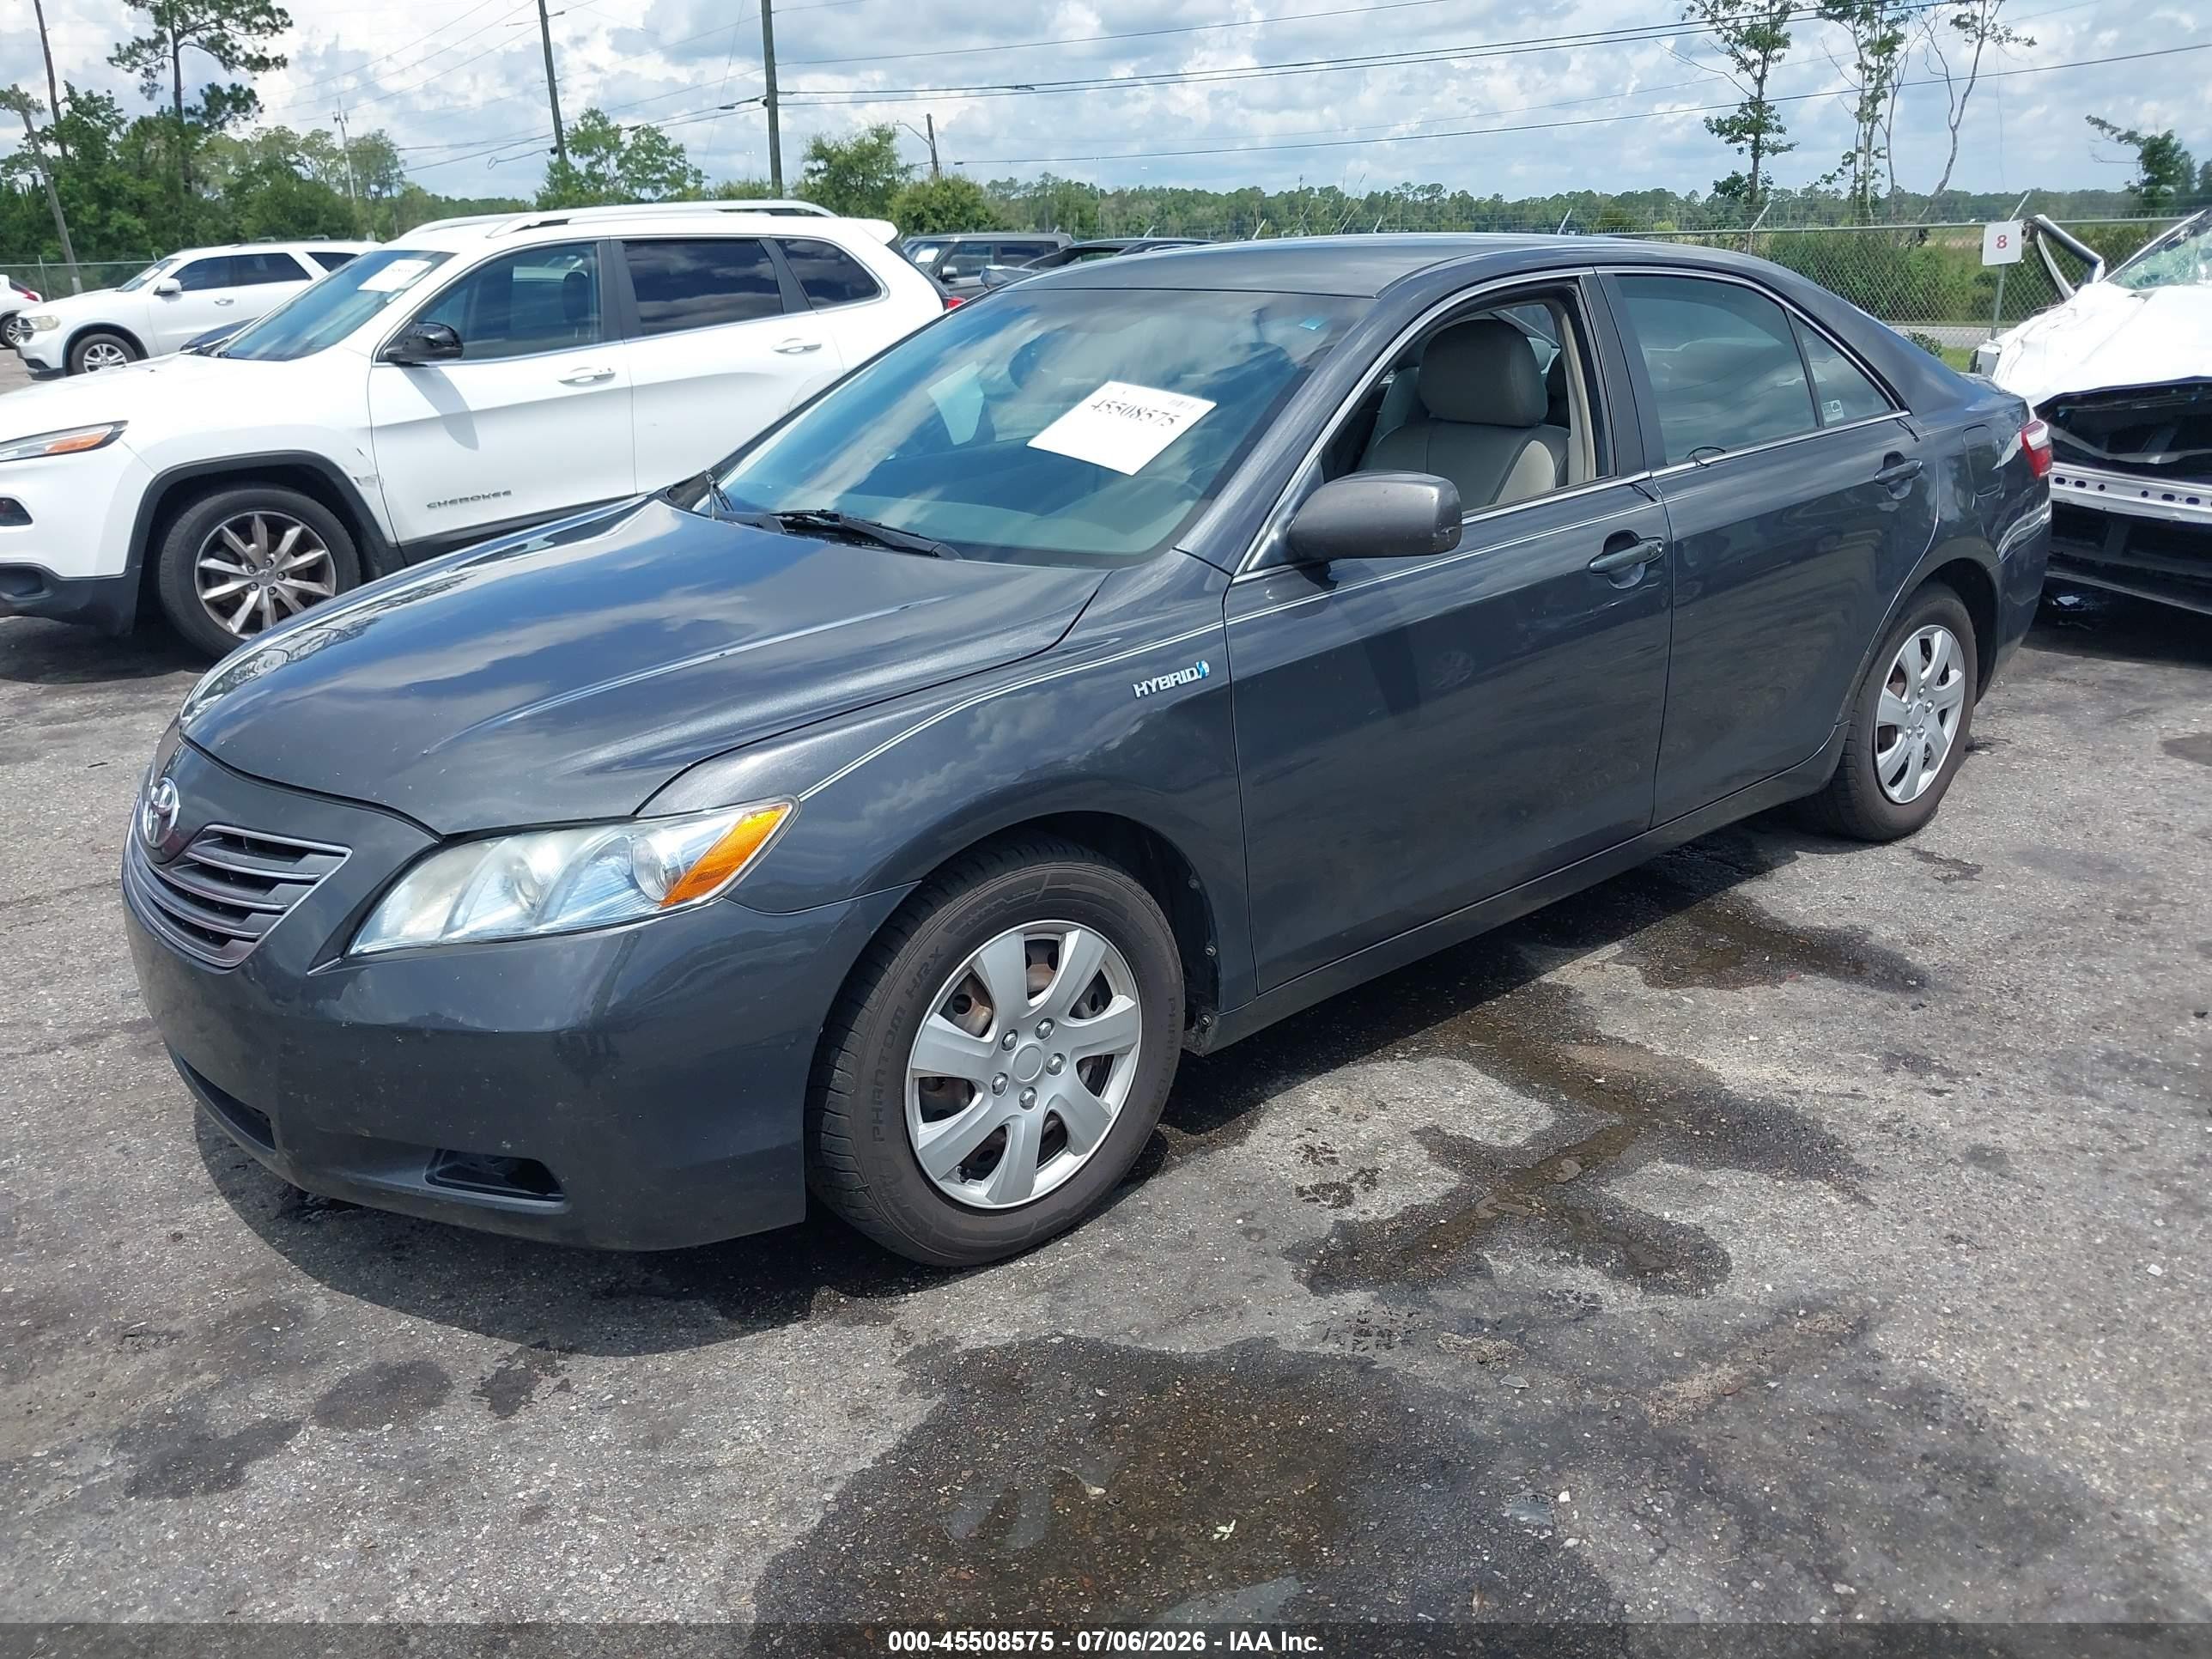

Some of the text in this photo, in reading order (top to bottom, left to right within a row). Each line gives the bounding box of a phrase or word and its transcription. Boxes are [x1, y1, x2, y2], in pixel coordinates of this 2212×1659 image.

[1996, 234, 2007, 249] 8
[1090, 398, 1182, 427] 45508575
[426, 489, 513, 508] CHEROKEE
[1132, 666, 1201, 699] HYBRID
